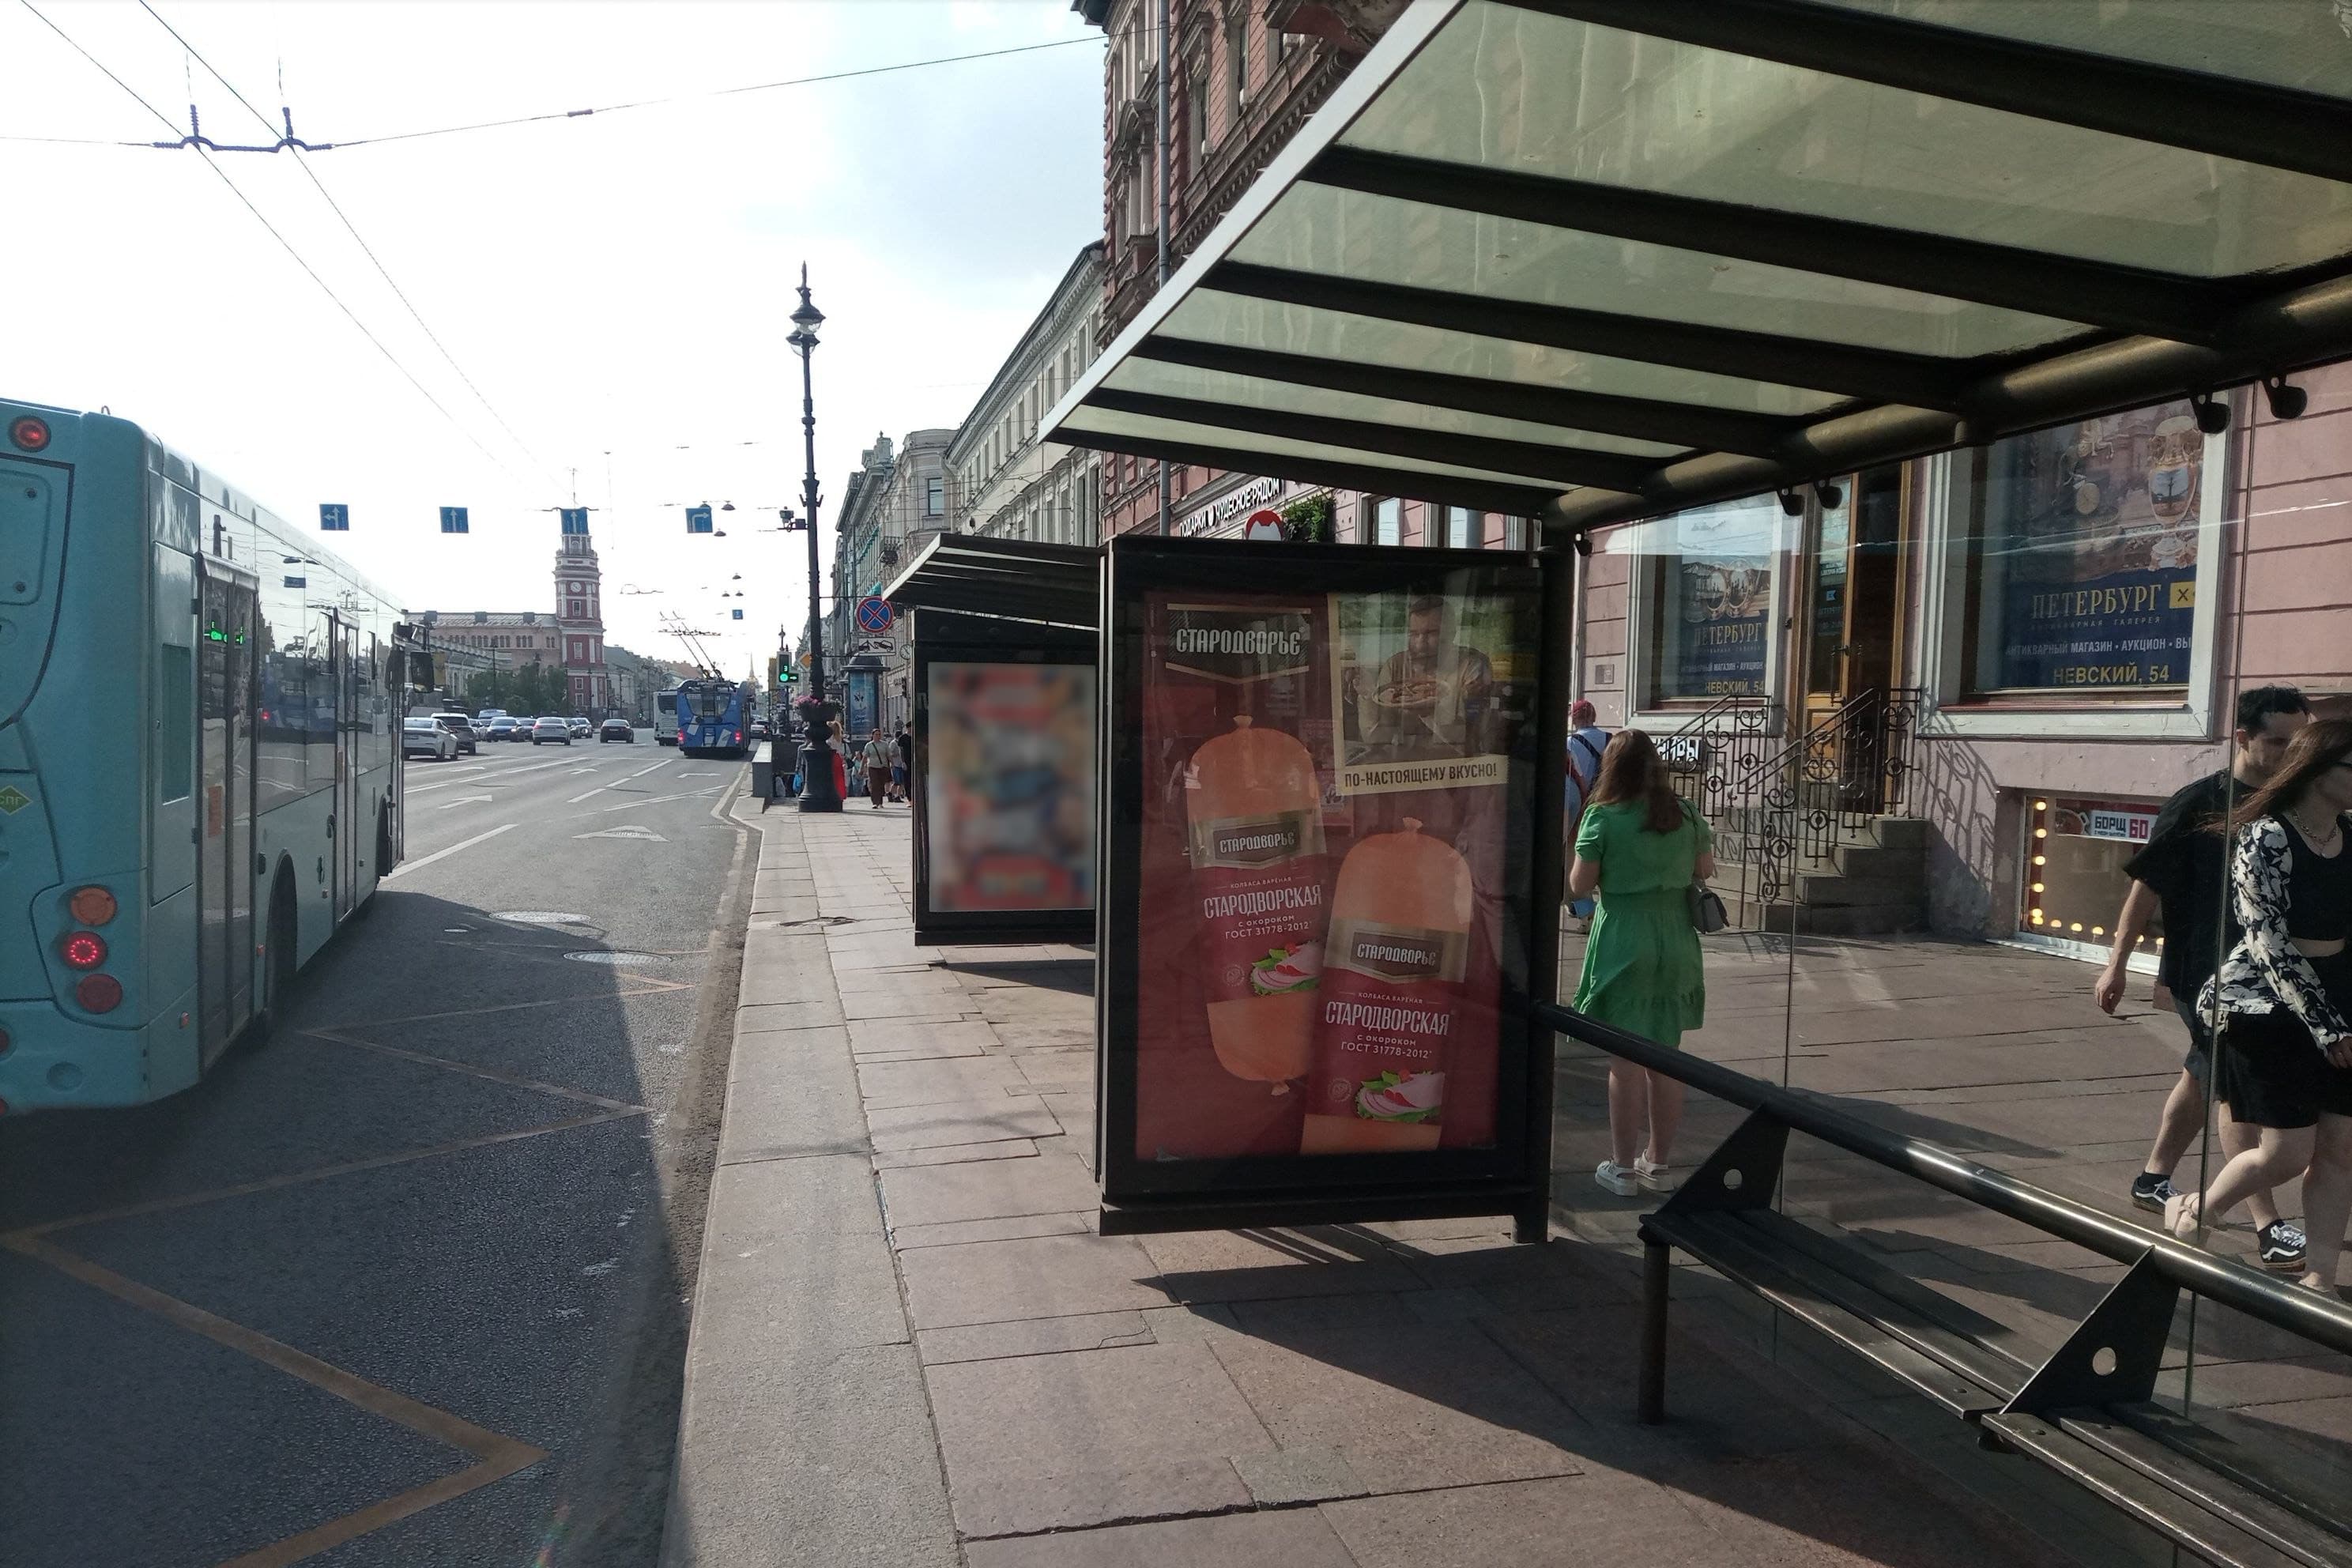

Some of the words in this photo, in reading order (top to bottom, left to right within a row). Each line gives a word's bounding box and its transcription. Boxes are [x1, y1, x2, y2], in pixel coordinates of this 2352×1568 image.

[1179, 510, 1206, 537] ПОДАРКИ
[1215, 487, 1251, 521] ЧУДЕСНОЕ
[1253, 477, 1280, 507] РЯДОМ
[2030, 584, 2162, 620] ПЕТЕРБУРГ
[2113, 616, 2162, 626] ГАЛЕРЕЯ
[1176, 628, 1301, 655] СТАРОДВОРЬЕ
[1694, 622, 1762, 646] ПЕТЕРБУРГ
[2071, 640, 2113, 654] МАГАЗИН
[2121, 638, 2166, 652] АУКЦИОН
[2149, 665, 2170, 683] 54
[1754, 680, 1766, 693] 54
[1344, 767, 1446, 787] ПО-НАСТОЯЩЕМУ
[1449, 763, 1498, 779] ВКУСНО!
[2095, 816, 2126, 833] БОРЩ
[2129, 818, 2149, 839] 60
[1219, 832, 1295, 854] СТАРОДВОРЬЕ
[1230, 880, 1261, 889] КОЛБАСА
[1204, 884, 1322, 919] СТАРОДВОРСКАЯ
[1225, 928, 1253, 940] ГОСТ
[1357, 943, 1437, 967] СТАРОДВОРЬЕ
[1358, 993, 1391, 1001] КОЛБАСА
[1325, 1001, 1450, 1035] СТАРОДВОРСКАЯ
[1341, 1041, 1370, 1053] ГОСТ
